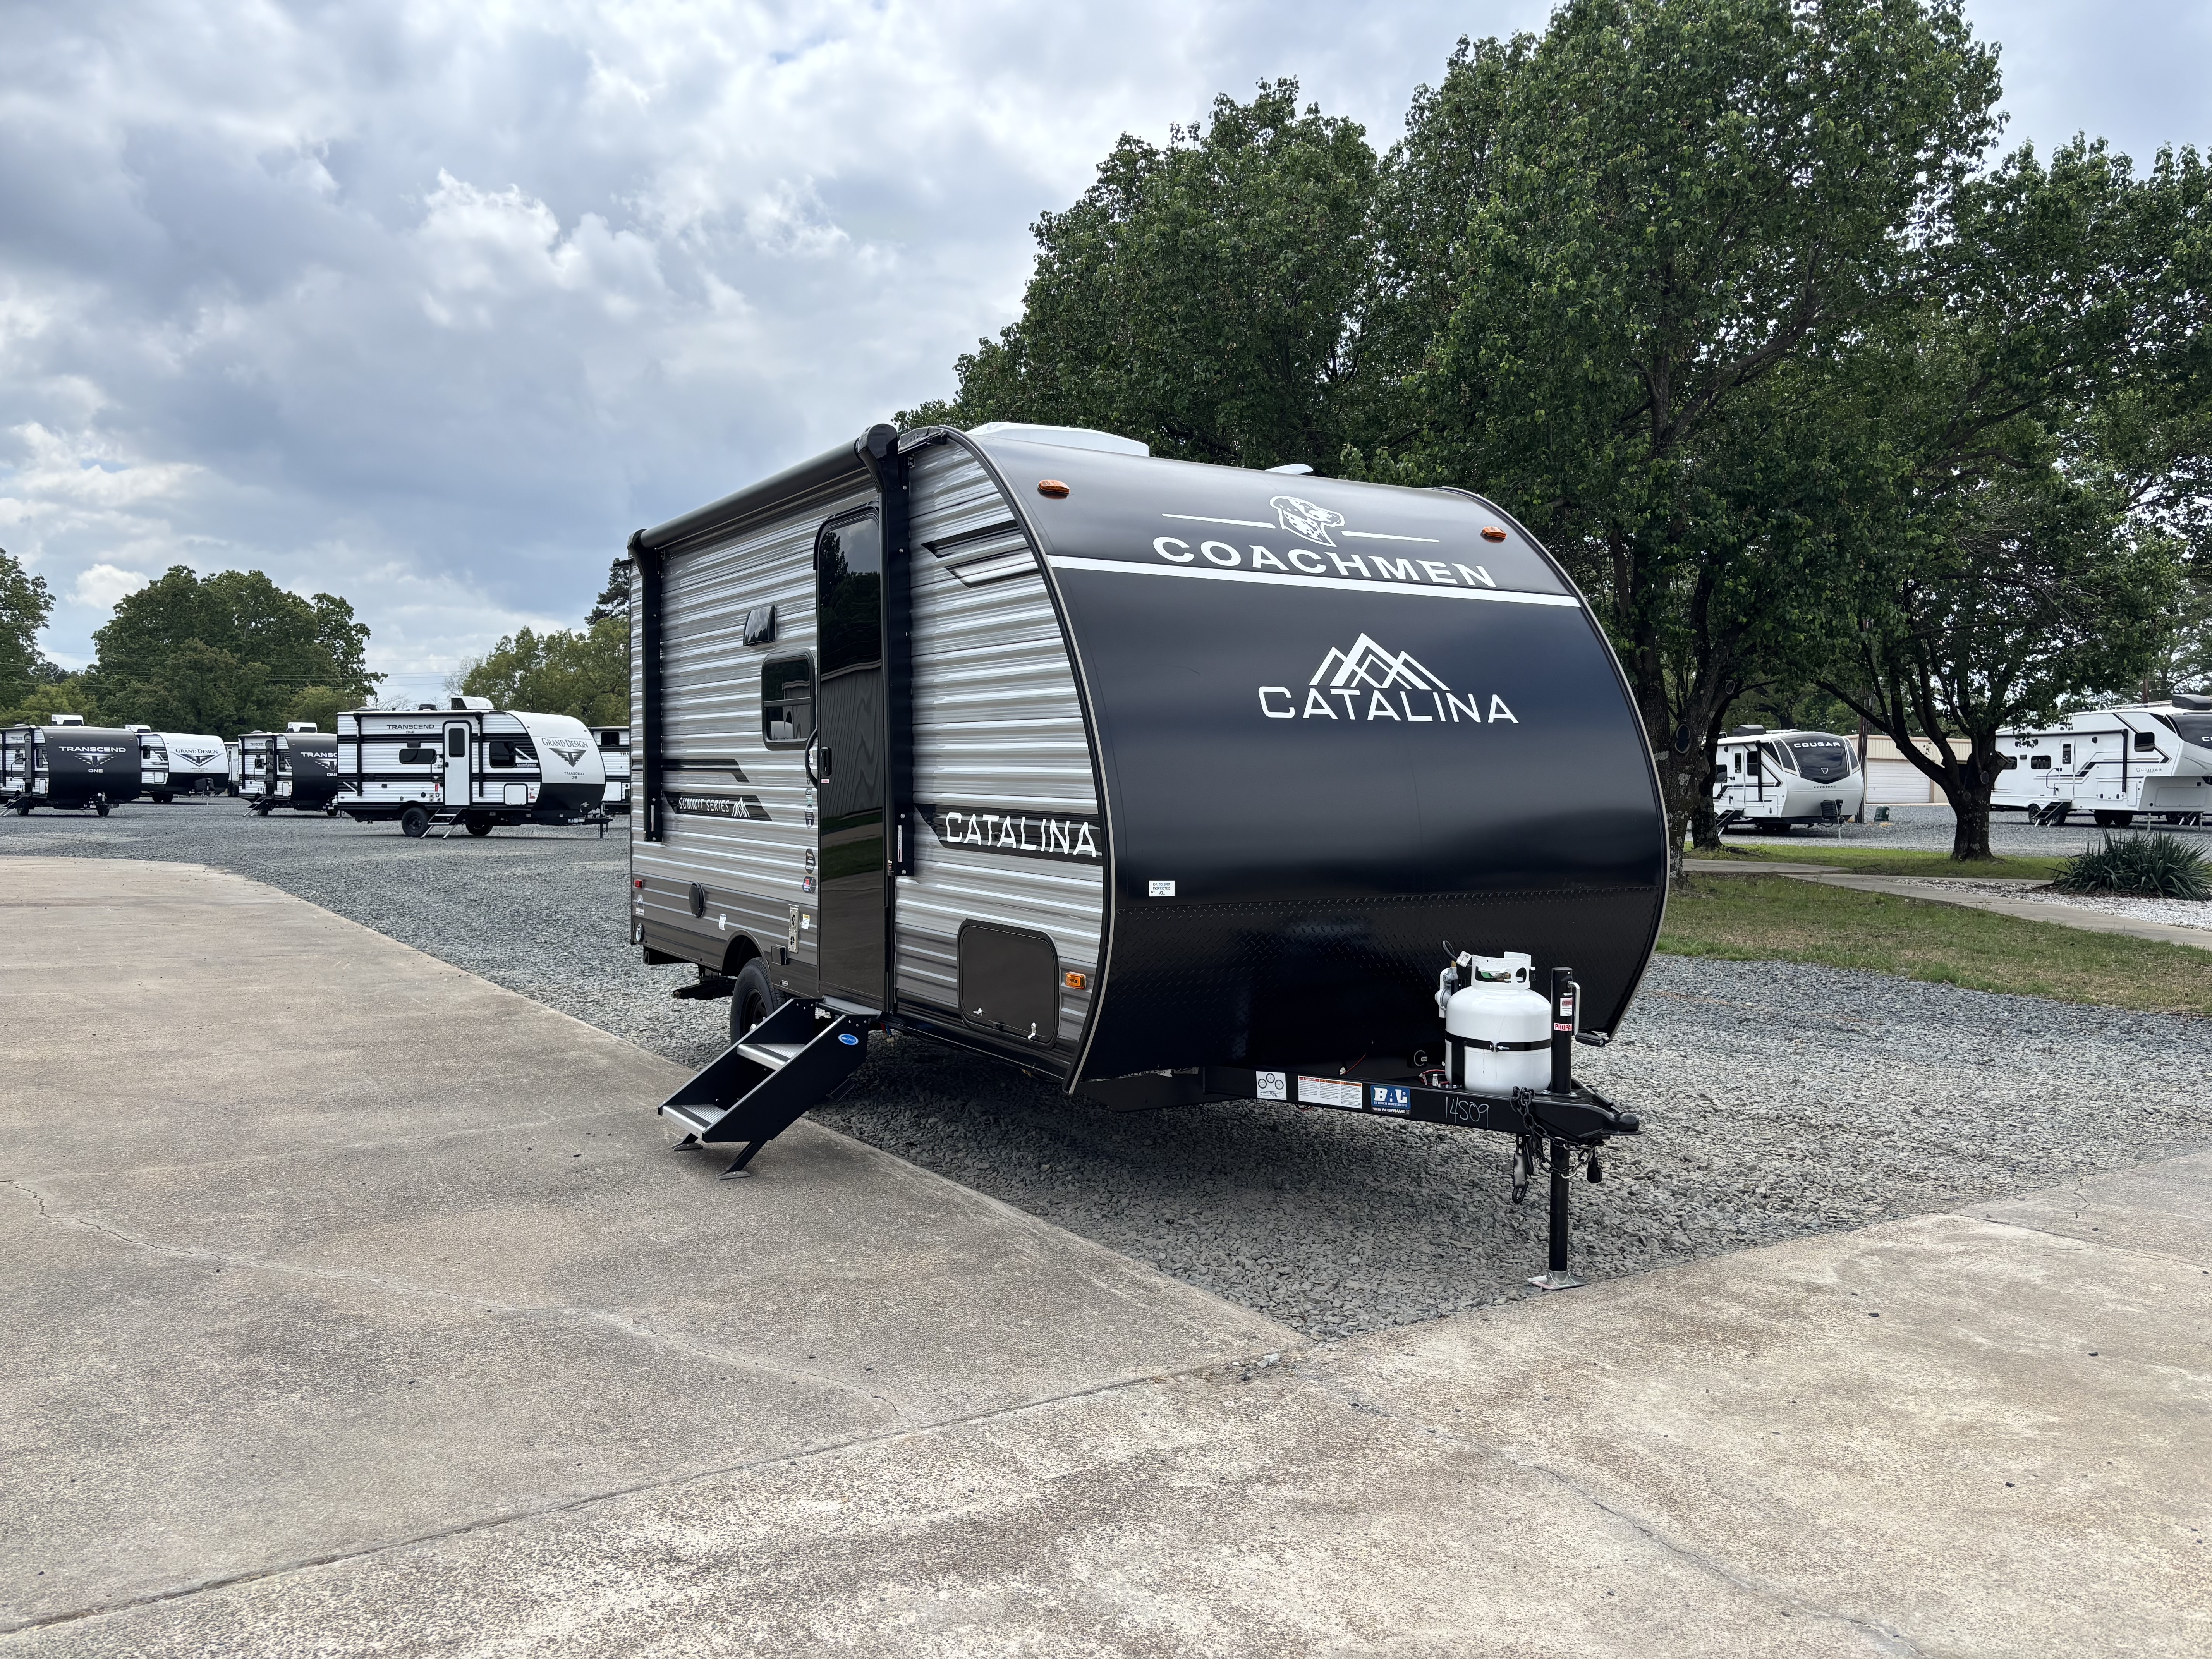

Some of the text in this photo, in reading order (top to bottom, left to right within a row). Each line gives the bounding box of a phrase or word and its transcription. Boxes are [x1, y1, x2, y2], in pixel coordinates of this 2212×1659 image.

[1153, 536, 1496, 587] COACHMEN
[1258, 686, 1519, 723] CATALINA
[542, 738, 588, 748] GRAND DESIGN
[679, 797, 729, 812] SUMMIT SERIES
[946, 812, 1096, 857] CATALINA
[1374, 1087, 1407, 1103] BAL
